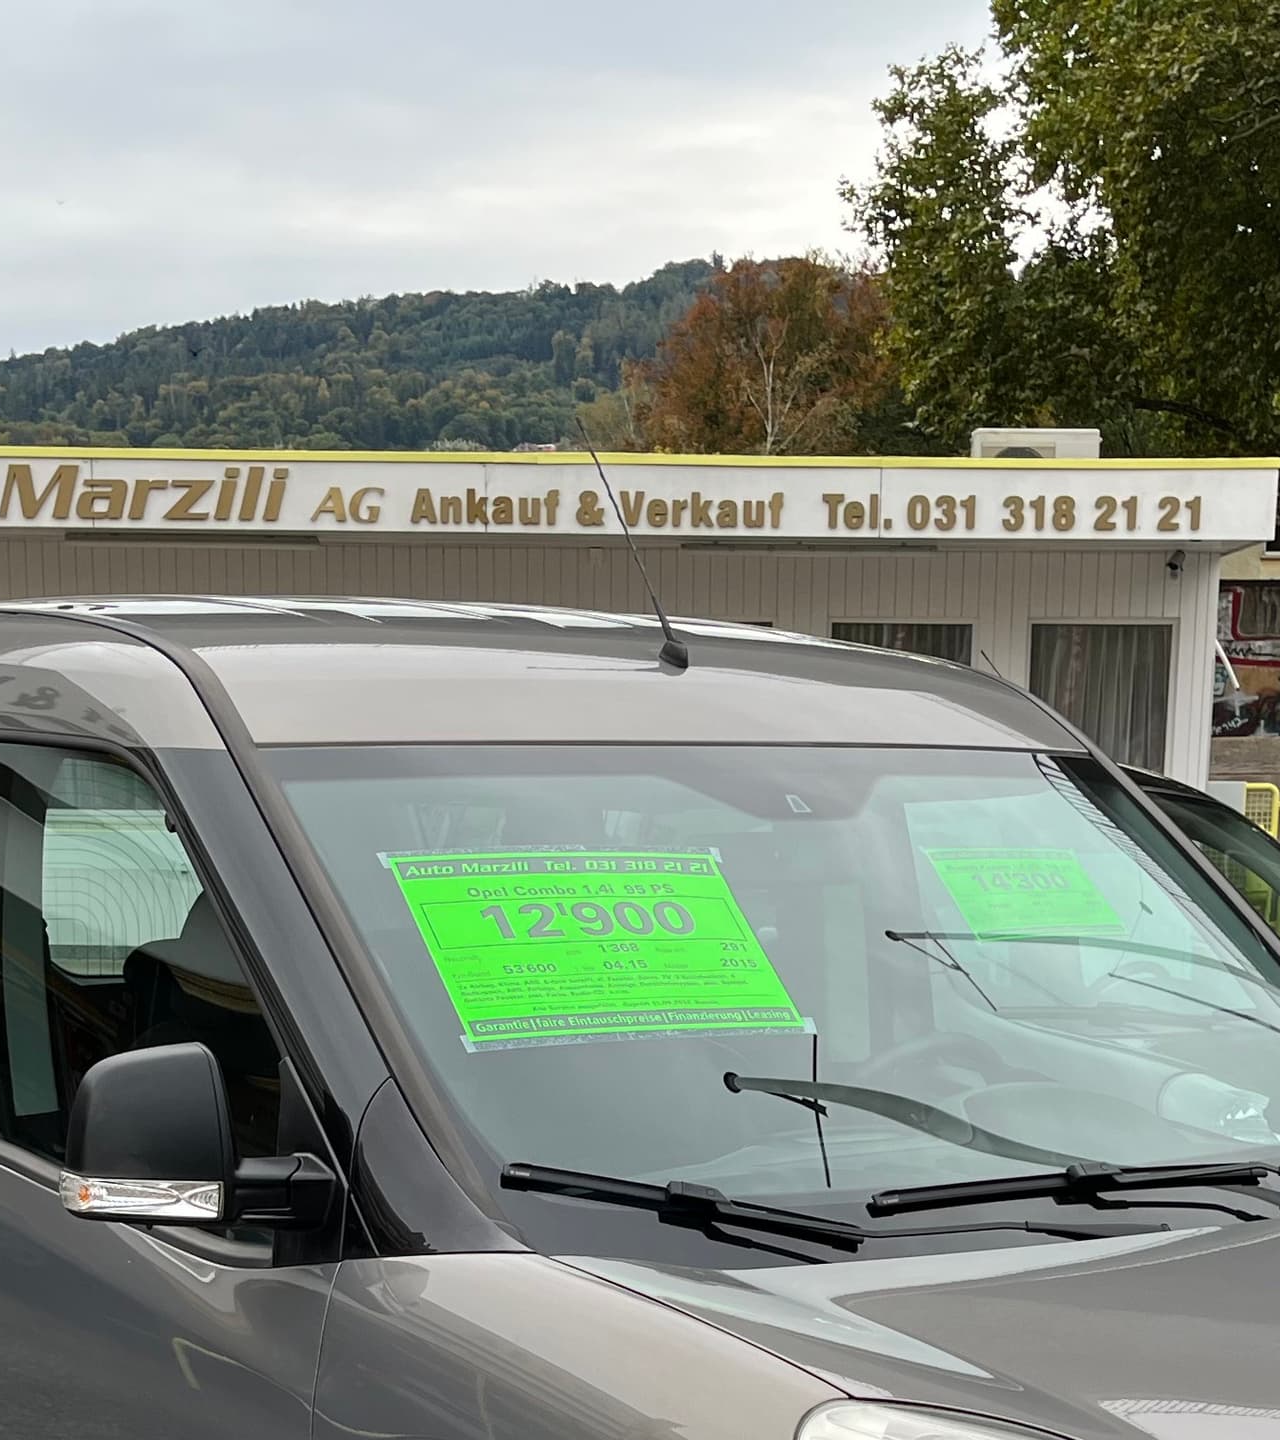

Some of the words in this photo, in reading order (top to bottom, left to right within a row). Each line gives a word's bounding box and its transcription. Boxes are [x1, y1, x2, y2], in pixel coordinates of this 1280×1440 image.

[310, 485, 386, 524] AG
[410, 487, 560, 527] Ankauf
[575, 490, 605, 527] &
[620, 489, 785, 530] Verkauf
[822, 493, 894, 531] Tel.
[906, 494, 977, 532] 031
[1001, 495, 1077, 532] 318
[1093, 495, 1141, 532] 21
[1156, 495, 1203, 532] 21
[406, 864, 455, 877] Auto
[461, 861, 529, 873] Marzili
[544, 860, 577, 871] Tel.
[585, 860, 617, 871] 031
[624, 860, 657, 871] 318
[663, 861, 682, 872] 21
[689, 862, 708, 873] 21
[467, 886, 508, 899] Opel
[513, 884, 577, 897] Combo
[623, 883, 646, 895] 95
[649, 883, 677, 895] PS
[480, 900, 696, 940] 12'900
[719, 957, 758, 969] 2015
